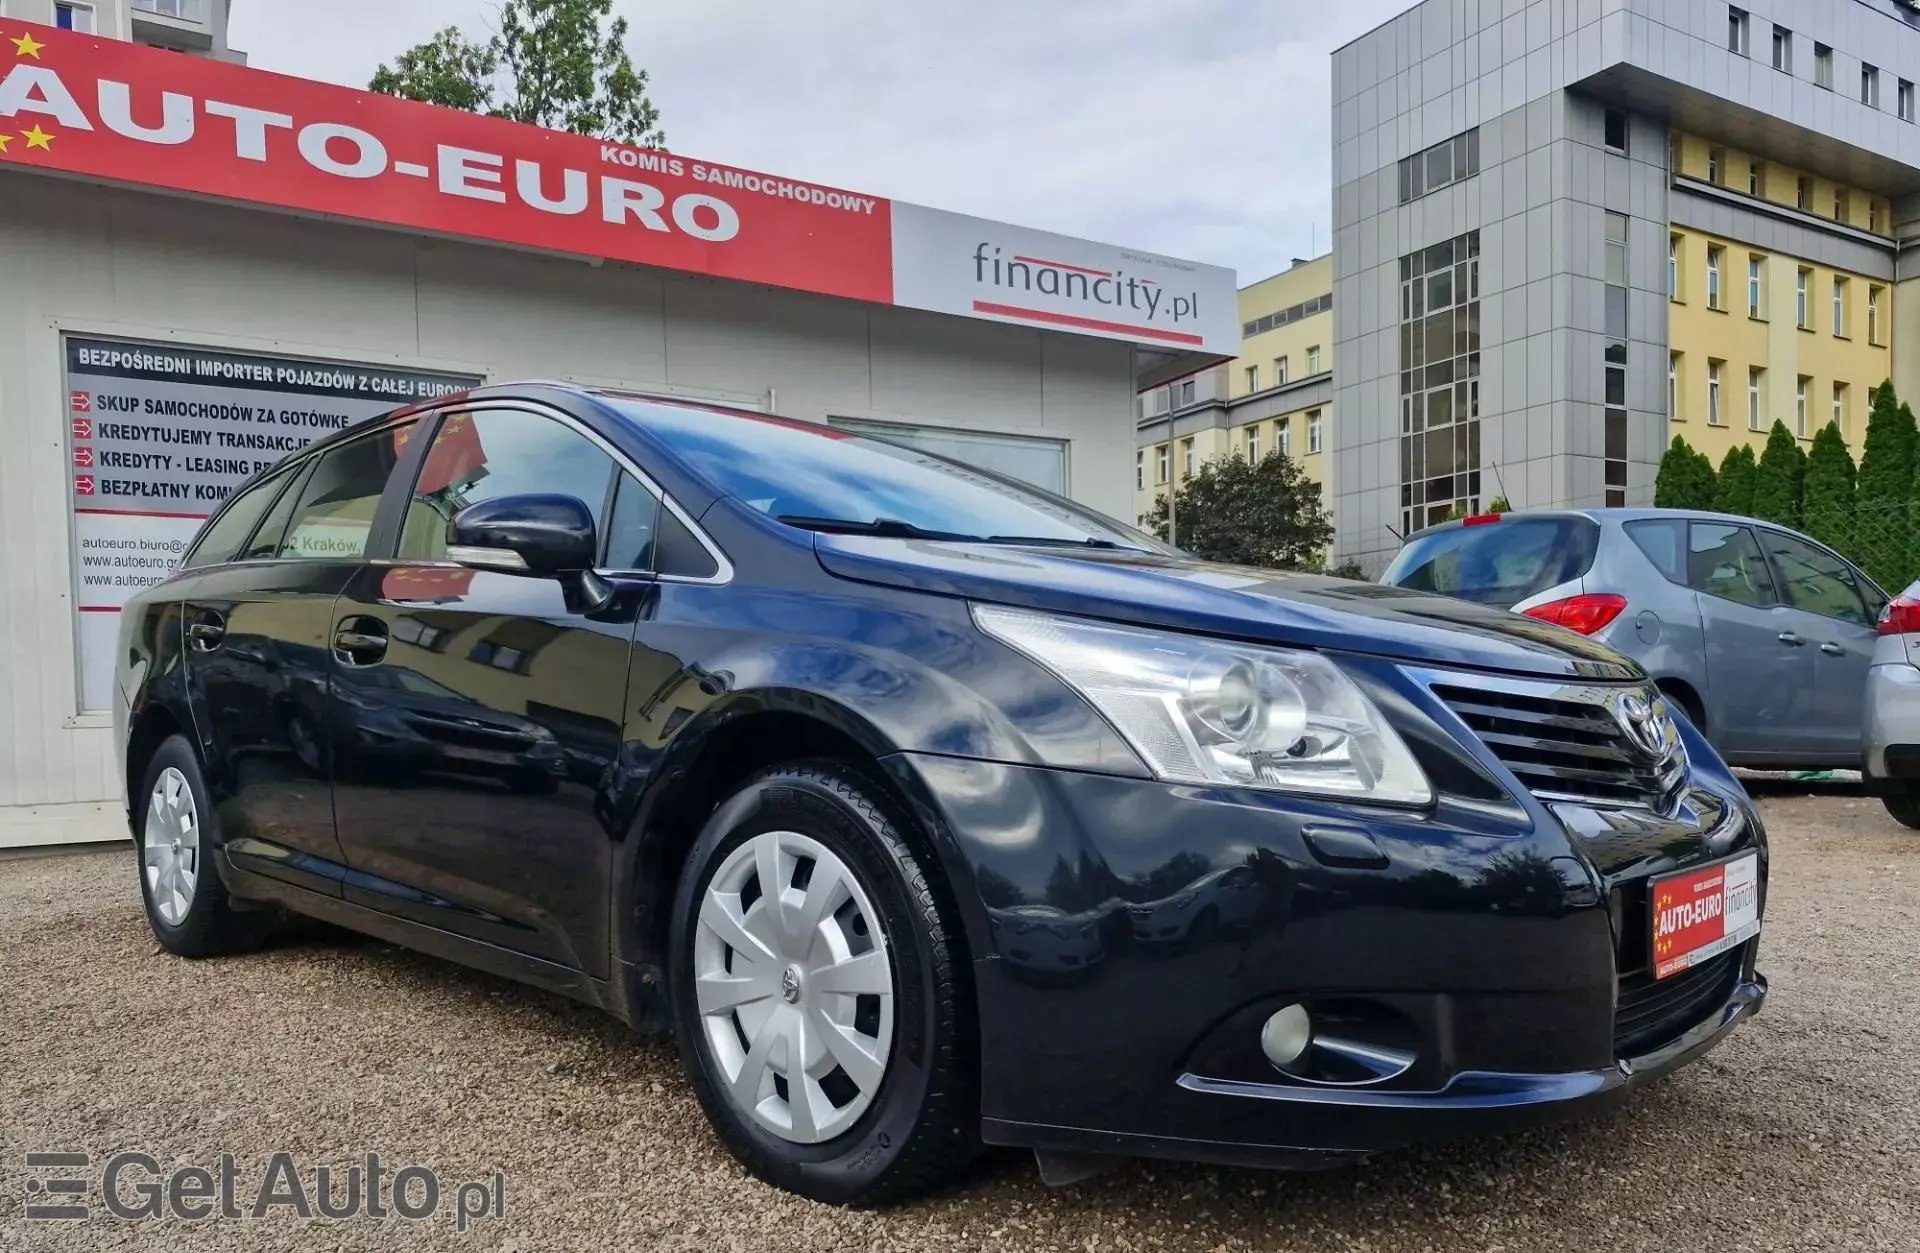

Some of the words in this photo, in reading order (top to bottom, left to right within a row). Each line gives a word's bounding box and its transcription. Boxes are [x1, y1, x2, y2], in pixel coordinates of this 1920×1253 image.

[0, 63, 740, 242] AUTO-EURO
[600, 145, 685, 177] KOMIS
[691, 164, 877, 215] SAMOCHODOWY
[972, 241, 1199, 323] financity.pl
[79, 348, 191, 375] BEZPOŚREDNI
[195, 359, 273, 383] IMPORTER
[276, 367, 355, 391] POJAZDÓW
[358, 375, 369, 391] Z
[371, 377, 414, 396] CAŁEJ
[97, 394, 140, 413] SKUP
[144, 398, 253, 422] SAMOCHODÓW
[256, 408, 276, 424] ZA
[98, 422, 212, 446] KREDYTUJEMY
[99, 450, 173, 471] KREDYTY
[185, 456, 249, 475] LEASING
[101, 479, 190, 499] BEZPŁATNY
[1659, 892, 1722, 937] AUTO-EURO
